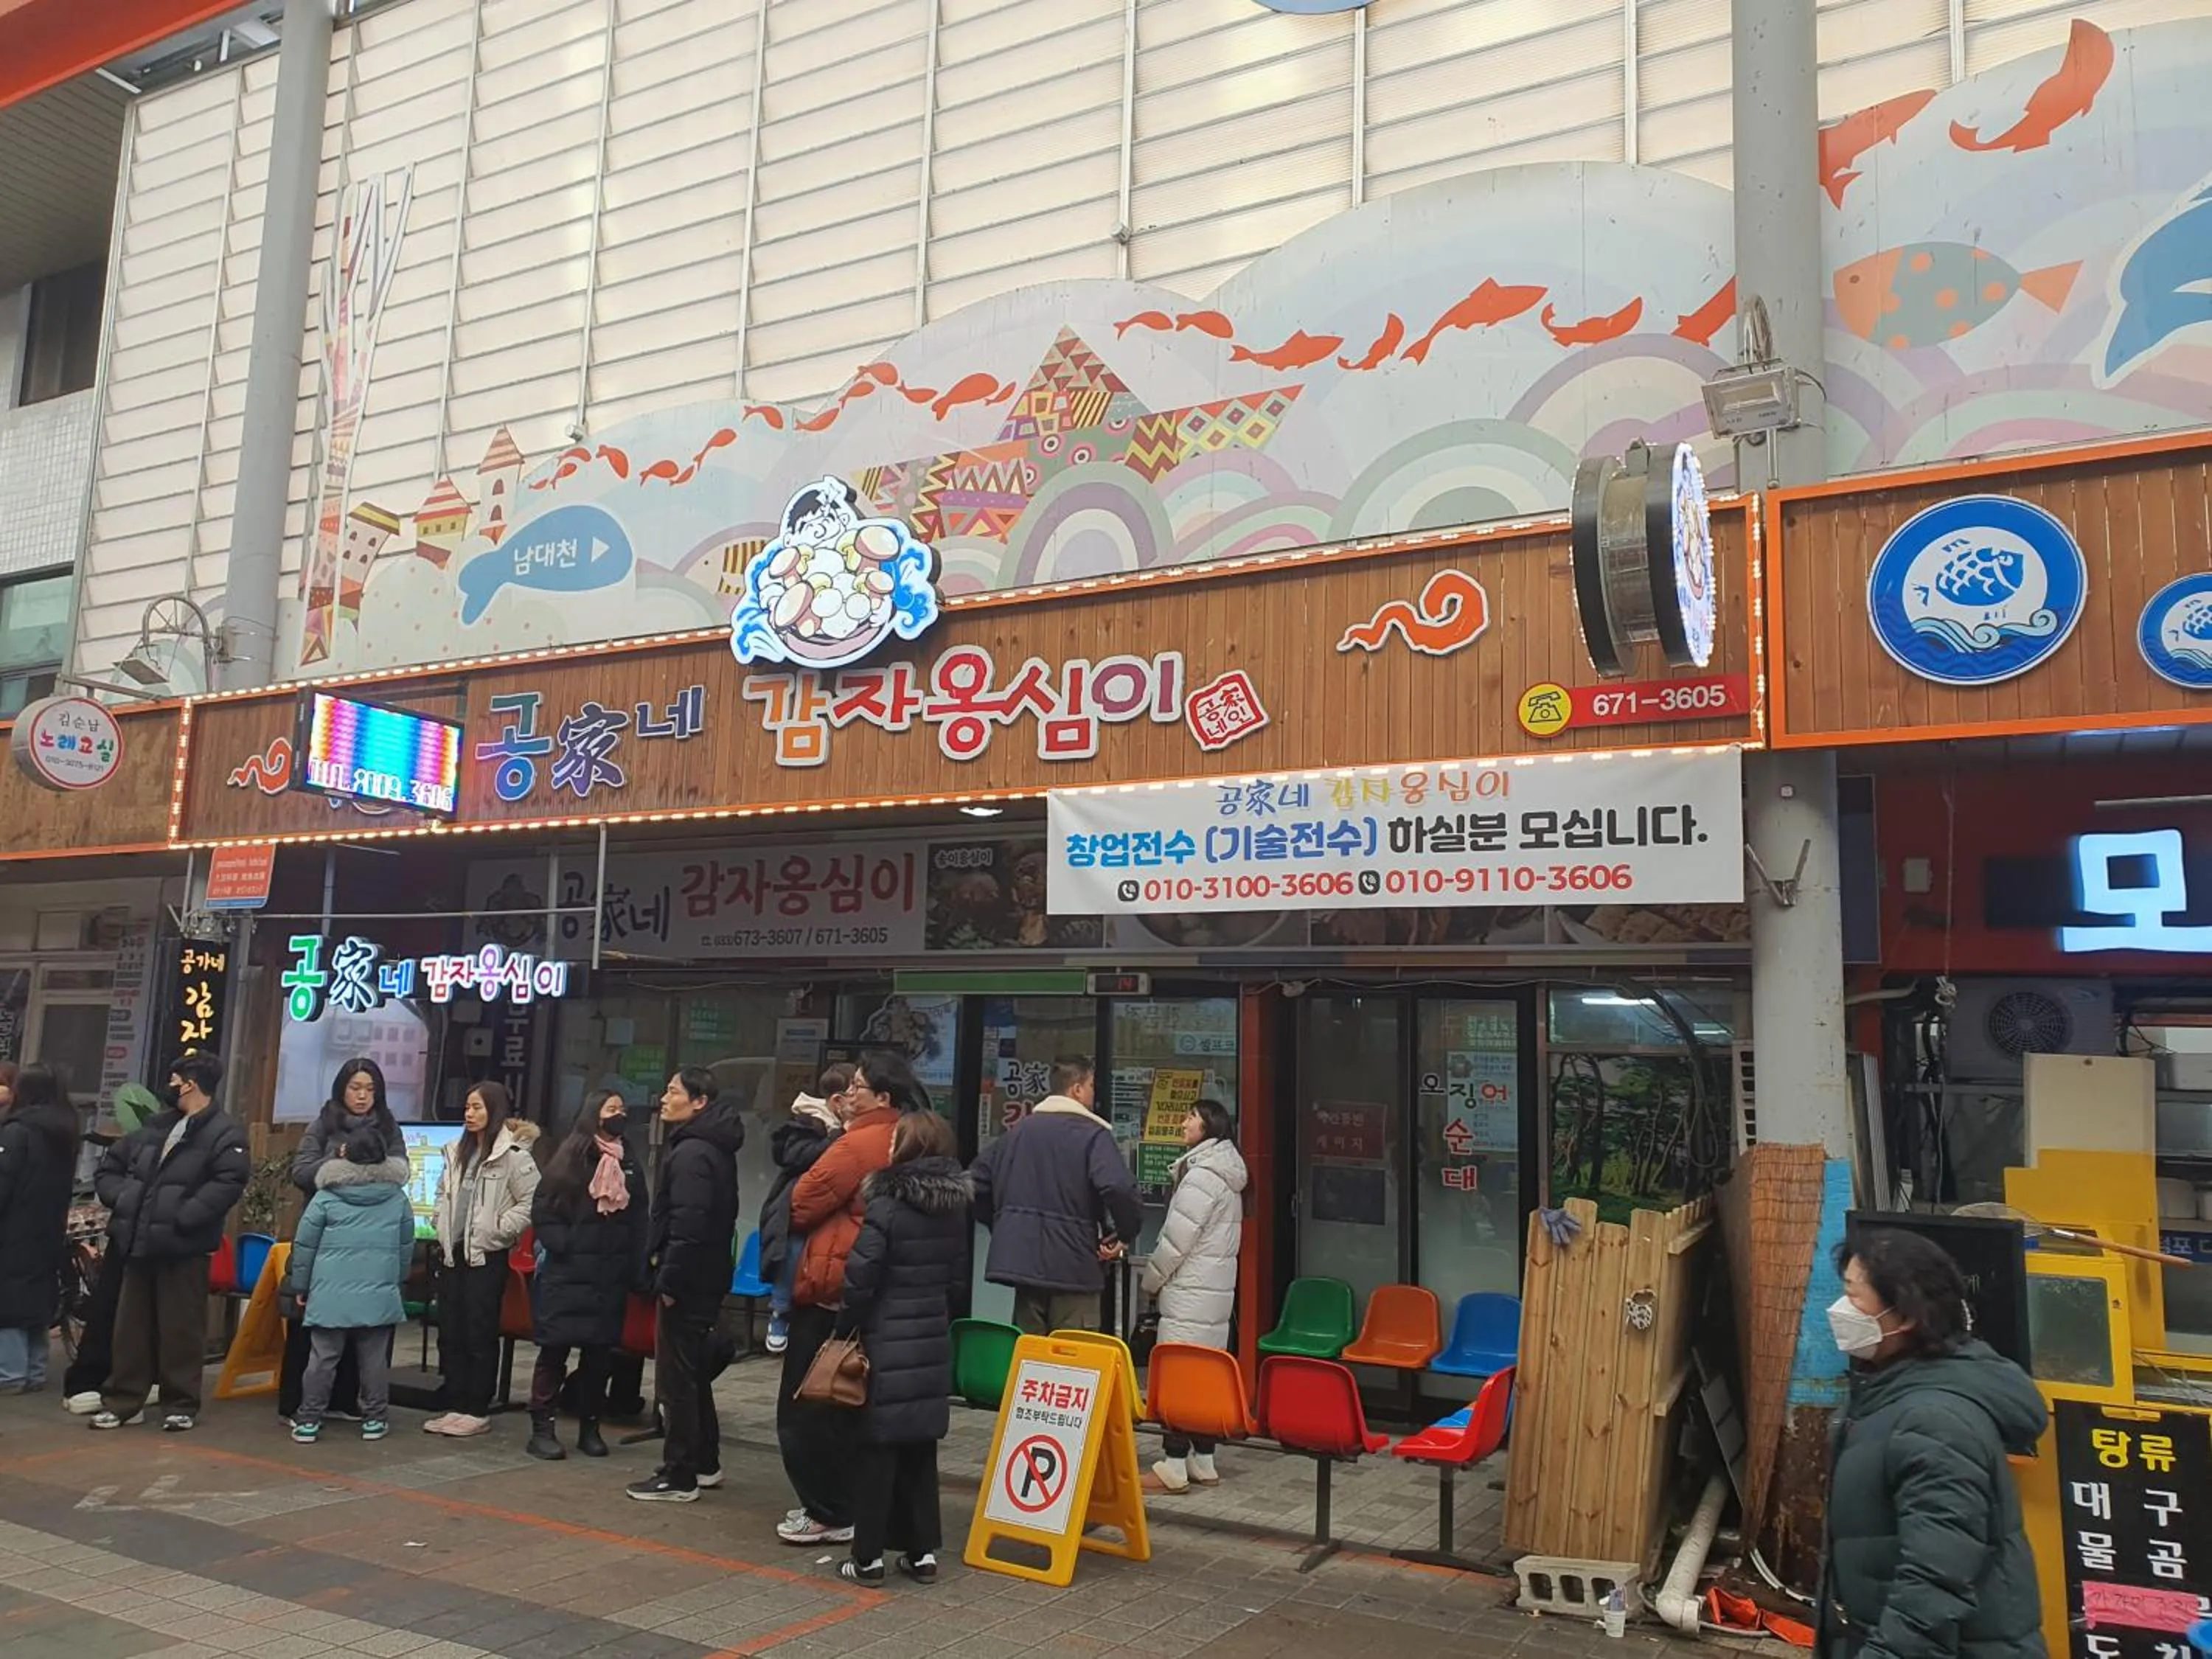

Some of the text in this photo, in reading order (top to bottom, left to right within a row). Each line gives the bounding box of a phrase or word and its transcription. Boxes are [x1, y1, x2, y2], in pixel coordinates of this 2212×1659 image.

[514, 538, 579, 576] 남대천
[744, 647, 1181, 764] 감자옹심이
[1592, 684, 1726, 717] 671-3605
[58, 710, 100, 732] 김순남
[40, 728, 114, 762] 노래교실
[1065, 829, 1196, 868] 창업전수
[1387, 811, 1507, 854] 하실분
[1519, 804, 1708, 849] 모십니다.
[681, 852, 914, 918] 감자옹심이
[1144, 863, 1632, 902] 010-3100-3606 010-9110-3606
[815, 926, 888, 945] 671-3605
[180, 949, 225, 974] 공가네
[420, 942, 568, 1004] 감자옹심이
[180, 981, 215, 1057] 감자
[1420, 1074, 1509, 1109] 오징어
[1021, 1380, 1089, 1412] 주차금지
[1015, 1406, 1083, 1429] 협조부탁드립니다
[2091, 1427, 2177, 1472] 탕류
